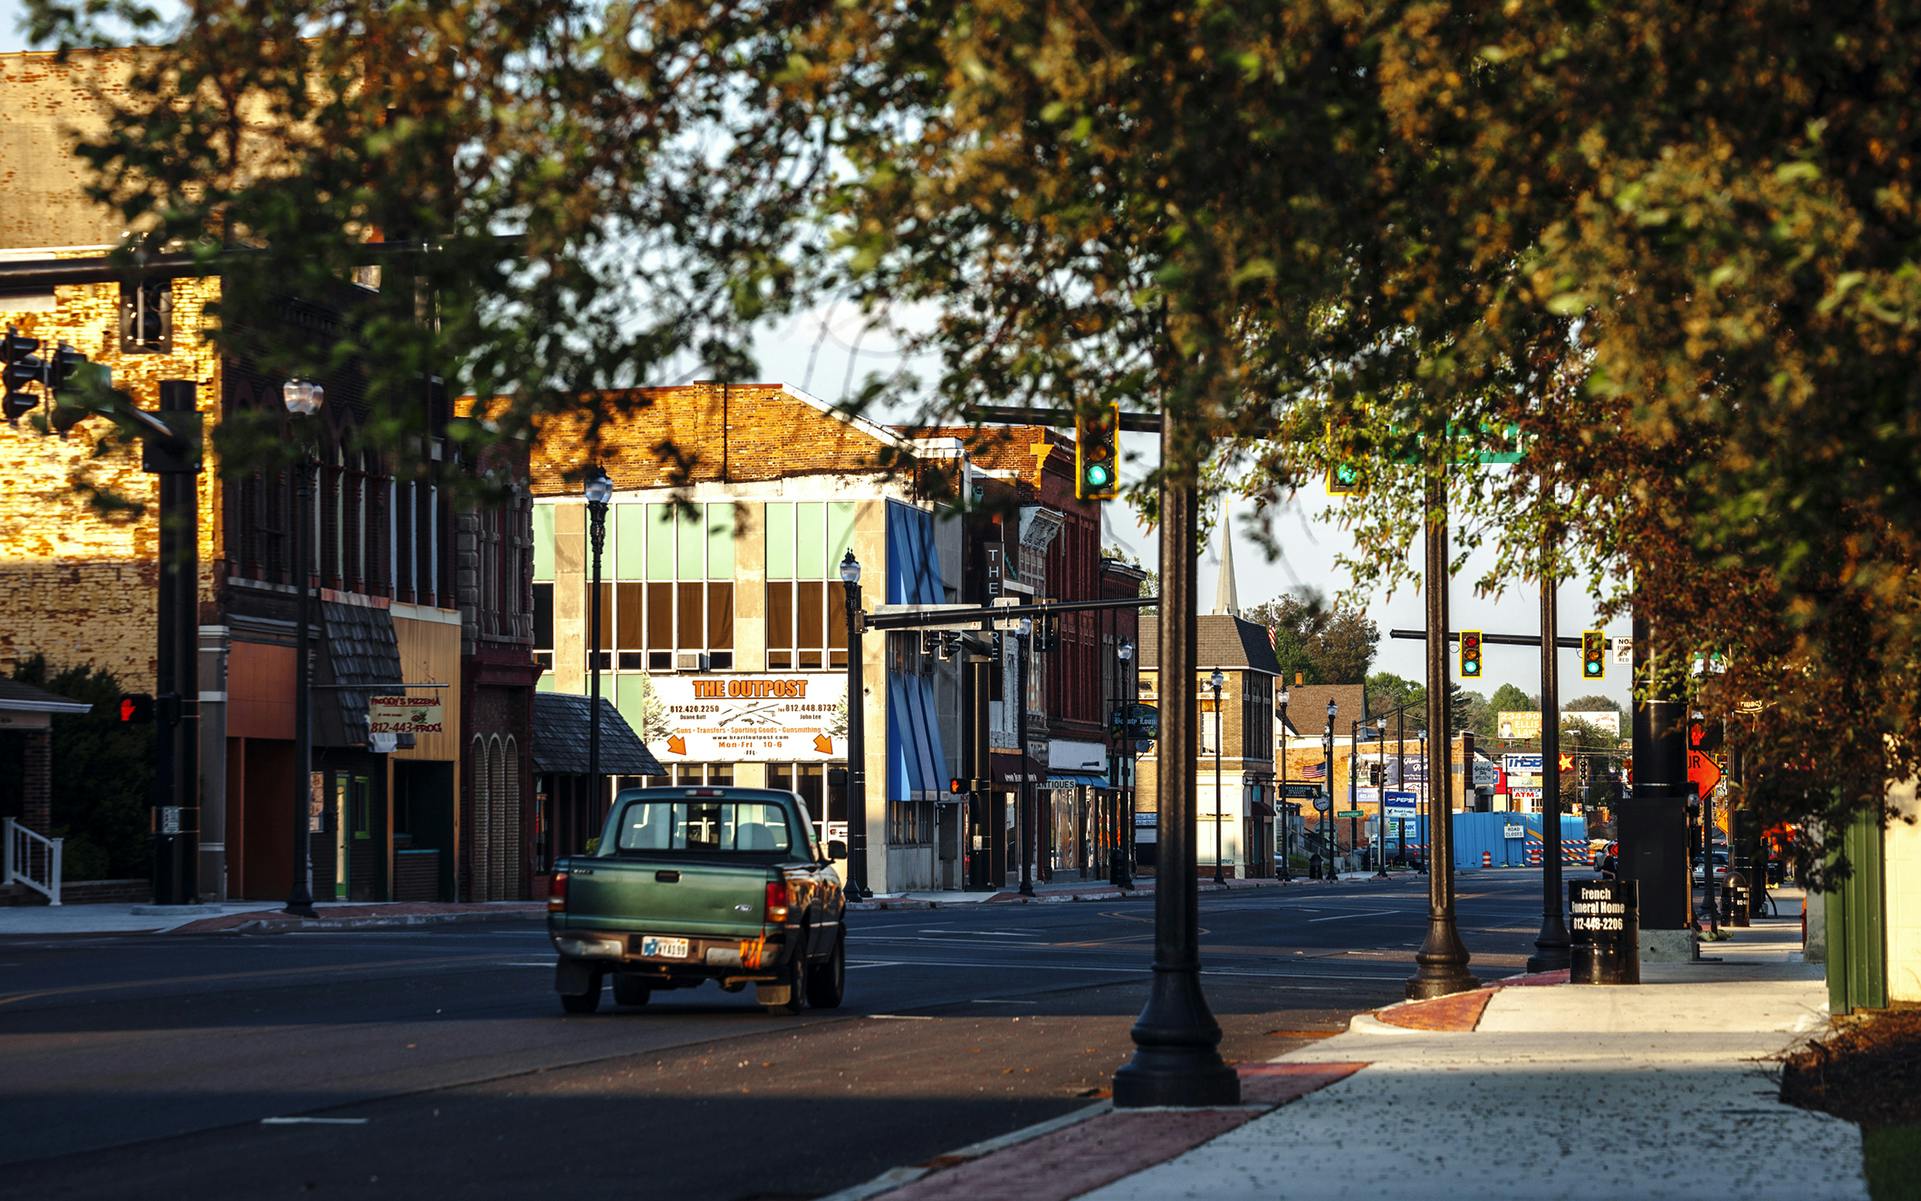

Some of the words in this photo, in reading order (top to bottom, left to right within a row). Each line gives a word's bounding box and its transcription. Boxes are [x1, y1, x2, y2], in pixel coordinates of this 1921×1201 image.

[692, 680, 726, 697] THE
[728, 680, 808, 697] OUTPOST
[670, 705, 720, 713] 812.420.2250
[371, 722, 442, 733] 812-443-FROG
[1036, 780, 1075, 788] ANTIQUES
[1581, 887, 1611, 900] French
[1571, 901, 1600, 914] Funeral
[1600, 901, 1625, 914] Home
